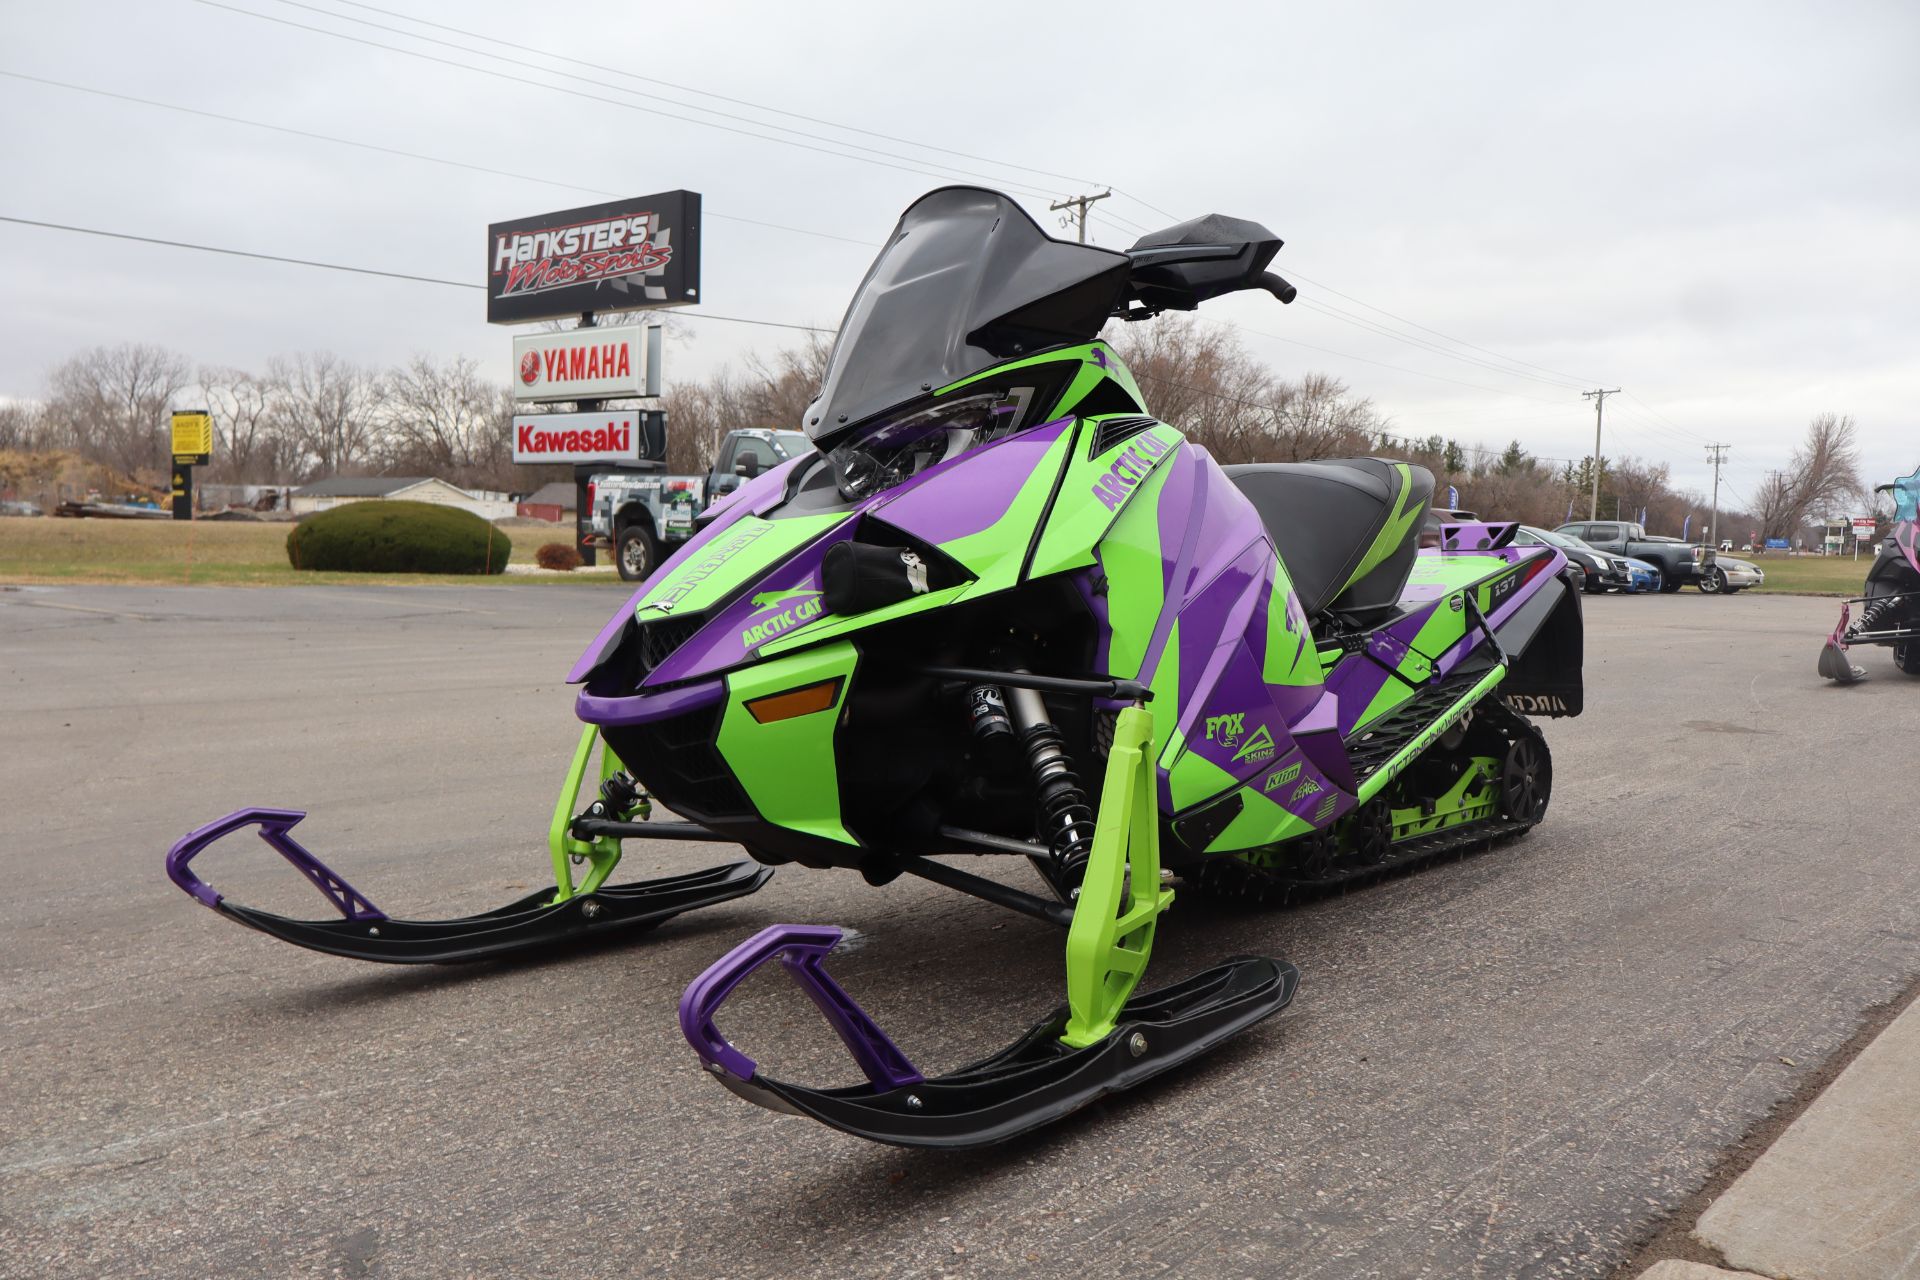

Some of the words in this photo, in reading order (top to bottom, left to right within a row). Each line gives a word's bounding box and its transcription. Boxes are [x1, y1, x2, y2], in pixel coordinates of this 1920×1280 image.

[543, 342, 631, 382] YAMAHA
[518, 421, 631, 453] Kawasaki
[1091, 446, 1153, 512] ARCTIC
[1135, 431, 1169, 457] CAT
[1494, 575, 1516, 597] 137
[741, 609, 796, 648] ARCTIC
[796, 596, 824, 624] CAT
[1205, 712, 1245, 746] FOX
[1244, 748, 1275, 760] SKINZ
